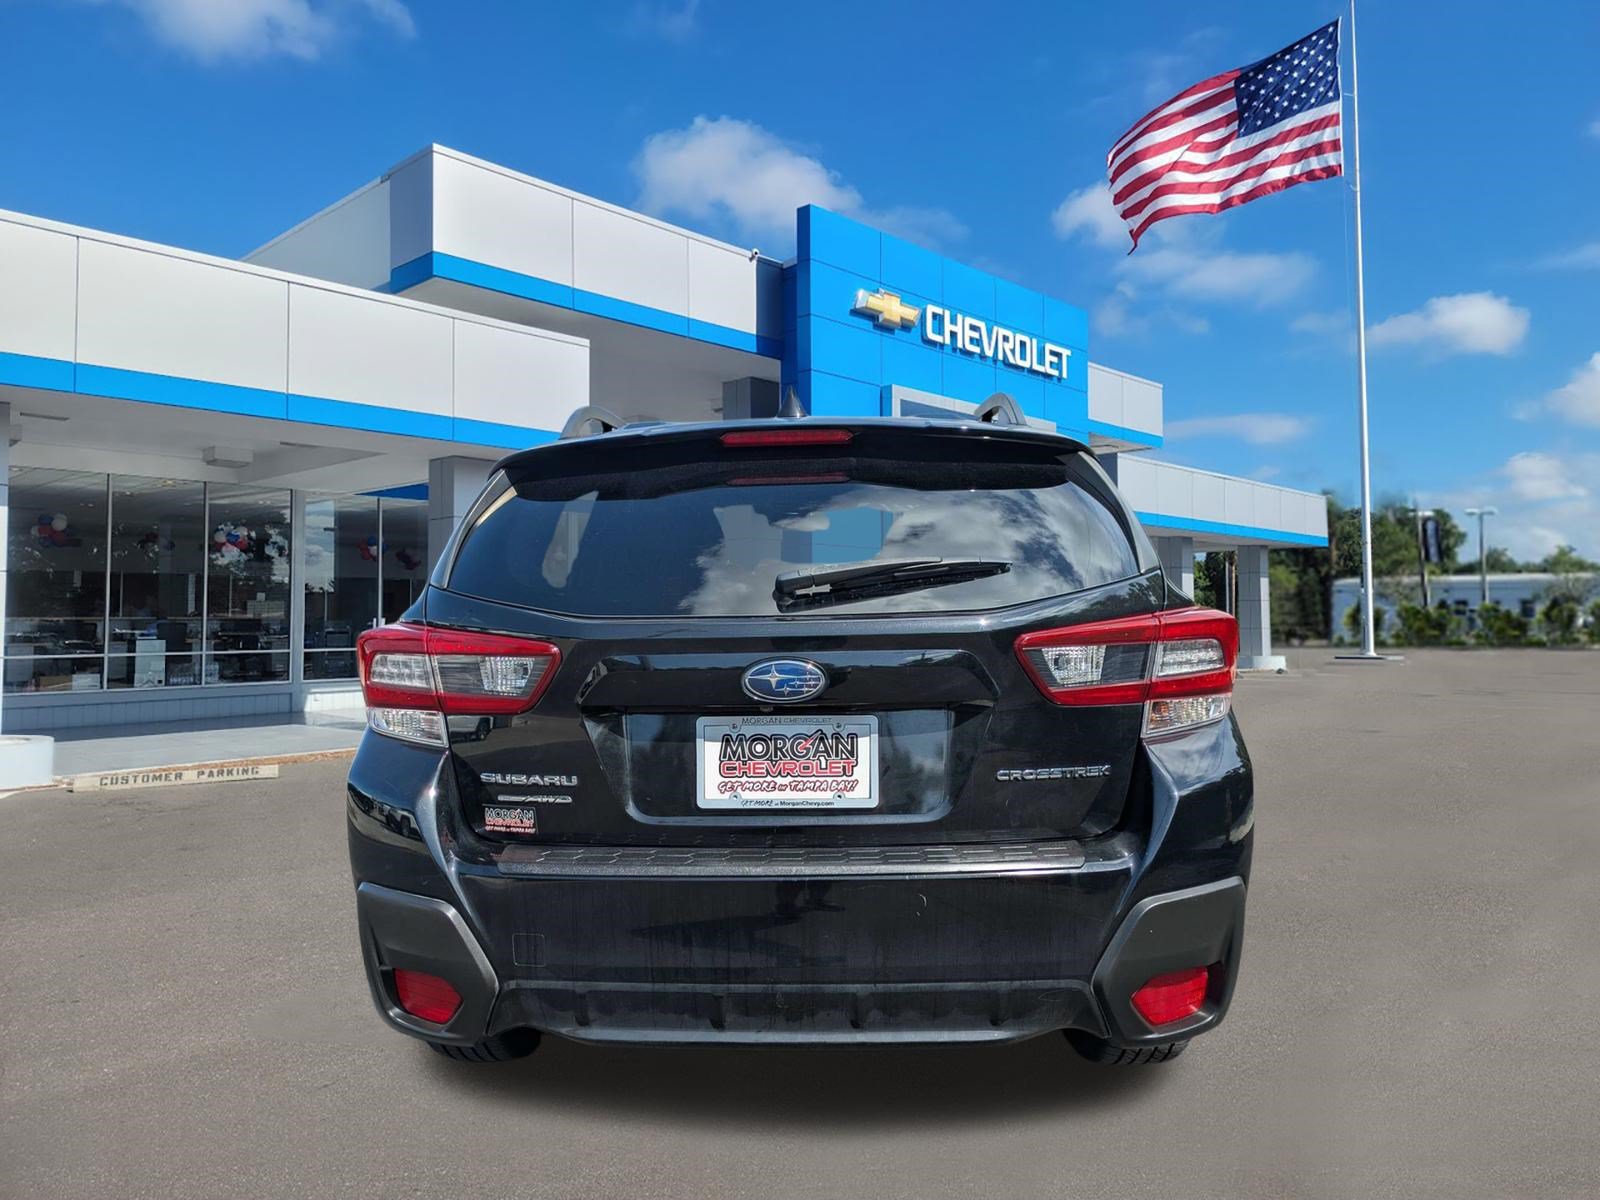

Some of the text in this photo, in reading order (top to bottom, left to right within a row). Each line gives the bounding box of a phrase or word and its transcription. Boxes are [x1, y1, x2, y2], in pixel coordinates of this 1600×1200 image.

[925, 304, 1072, 379] CHEVROLET
[741, 717, 782, 725] MORGAN
[719, 729, 859, 762] MORGAN
[100, 765, 260, 787] CUSTOMER PARKING
[720, 759, 858, 778] CHEVROLET
[996, 764, 1112, 781] CROSSTREK
[480, 772, 578, 786] SUBARU
[718, 780, 742, 794] GET
[741, 780, 776, 792] MORE
[789, 780, 828, 792] TAMPA
[829, 779, 859, 793] BAY!
[484, 807, 535, 821] MORGAN
